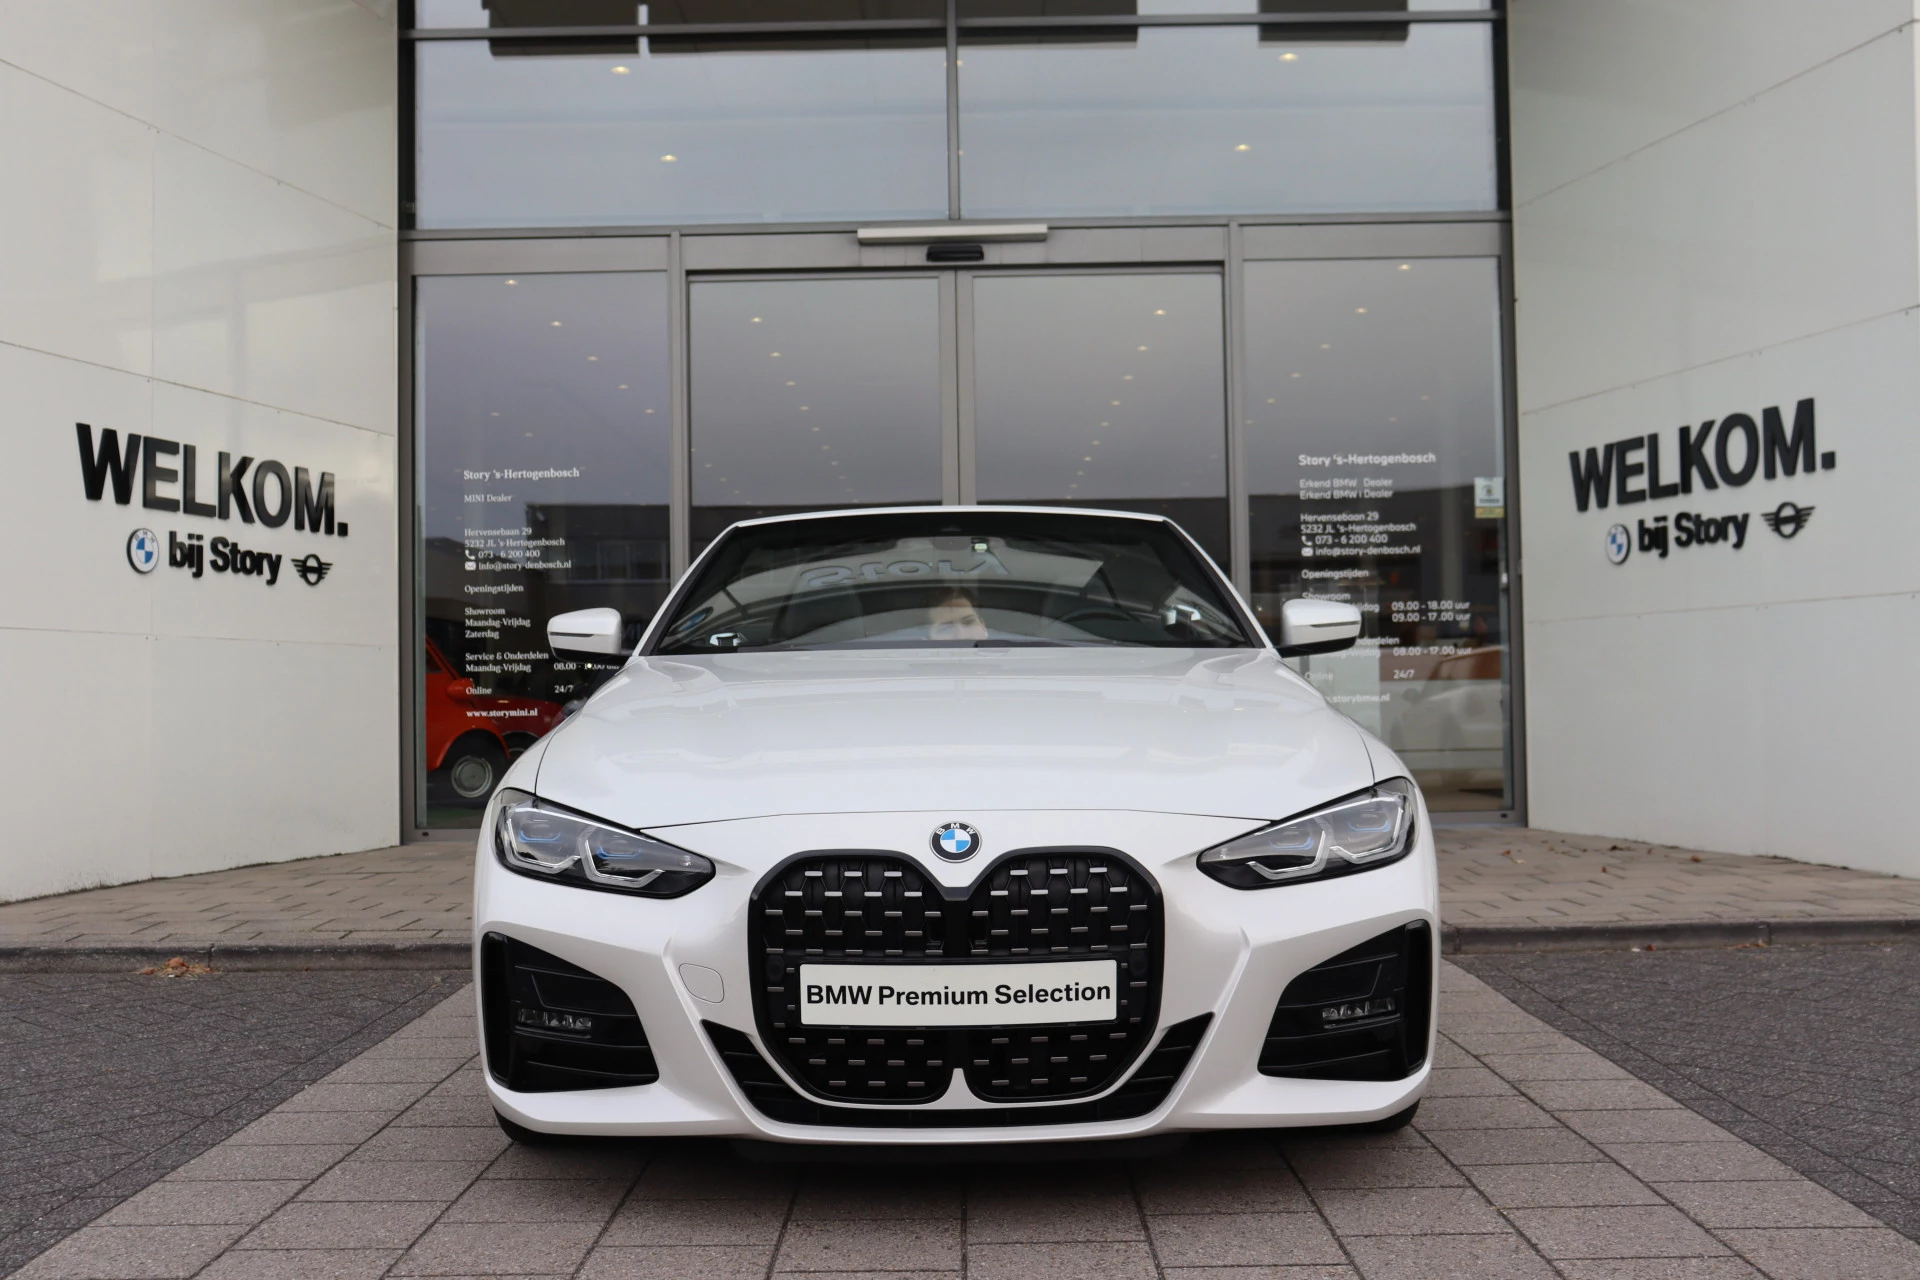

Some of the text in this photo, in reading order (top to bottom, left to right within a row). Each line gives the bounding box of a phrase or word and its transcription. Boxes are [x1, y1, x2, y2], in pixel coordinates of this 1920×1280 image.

[1569, 397, 1836, 512] WELKOM.
[1299, 454, 1331, 467] Story
[75, 422, 349, 537] WELKOM.
[464, 470, 490, 482] Story
[1300, 478, 1393, 488] Erkend BMW Dealer
[464, 493, 512, 503] MINI Dealer
[1300, 490, 1330, 499] Erkend
[1333, 490, 1357, 498] BMW
[1364, 489, 1393, 498] Dealer
[1301, 512, 1379, 522] Hervensebaan 29
[464, 527, 532, 537] Hervensebaan 29
[1301, 524, 1323, 533] 5232
[1325, 524, 1335, 533] JL
[1316, 536, 1332, 544] 073
[1341, 535, 1347, 544] 6
[1349, 535, 1367, 544] 200
[1369, 534, 1388, 543] 400
[1638, 512, 1749, 558] bij Story
[464, 539, 484, 548] 5232
[486, 539, 496, 547] JL
[169, 530, 282, 585] bij Story
[1302, 569, 1369, 580] Openingstijden
[464, 584, 524, 594] Openingstijden
[464, 606, 505, 615] Showroom
[1392, 602, 1419, 610] 09.00
[1428, 601, 1453, 610] 18.00
[1392, 613, 1420, 622] 09.00
[465, 618, 531, 628] Maandag-Vrijdag
[465, 629, 499, 640] Zaterdag
[1357, 636, 1399, 645] nderdelen
[465, 651, 549, 661] Service & Onderdelen
[1393, 647, 1421, 656] 08.00
[466, 663, 531, 673] Maandag-Vrijdag
[1393, 670, 1414, 678] 24/7
[466, 686, 492, 694] Online
[554, 685, 574, 694] 24/7
[467, 708, 538, 719] www.storymini.nl
[936, 823, 975, 835] BMW
[806, 982, 1111, 1005] BMW Premium Selection
